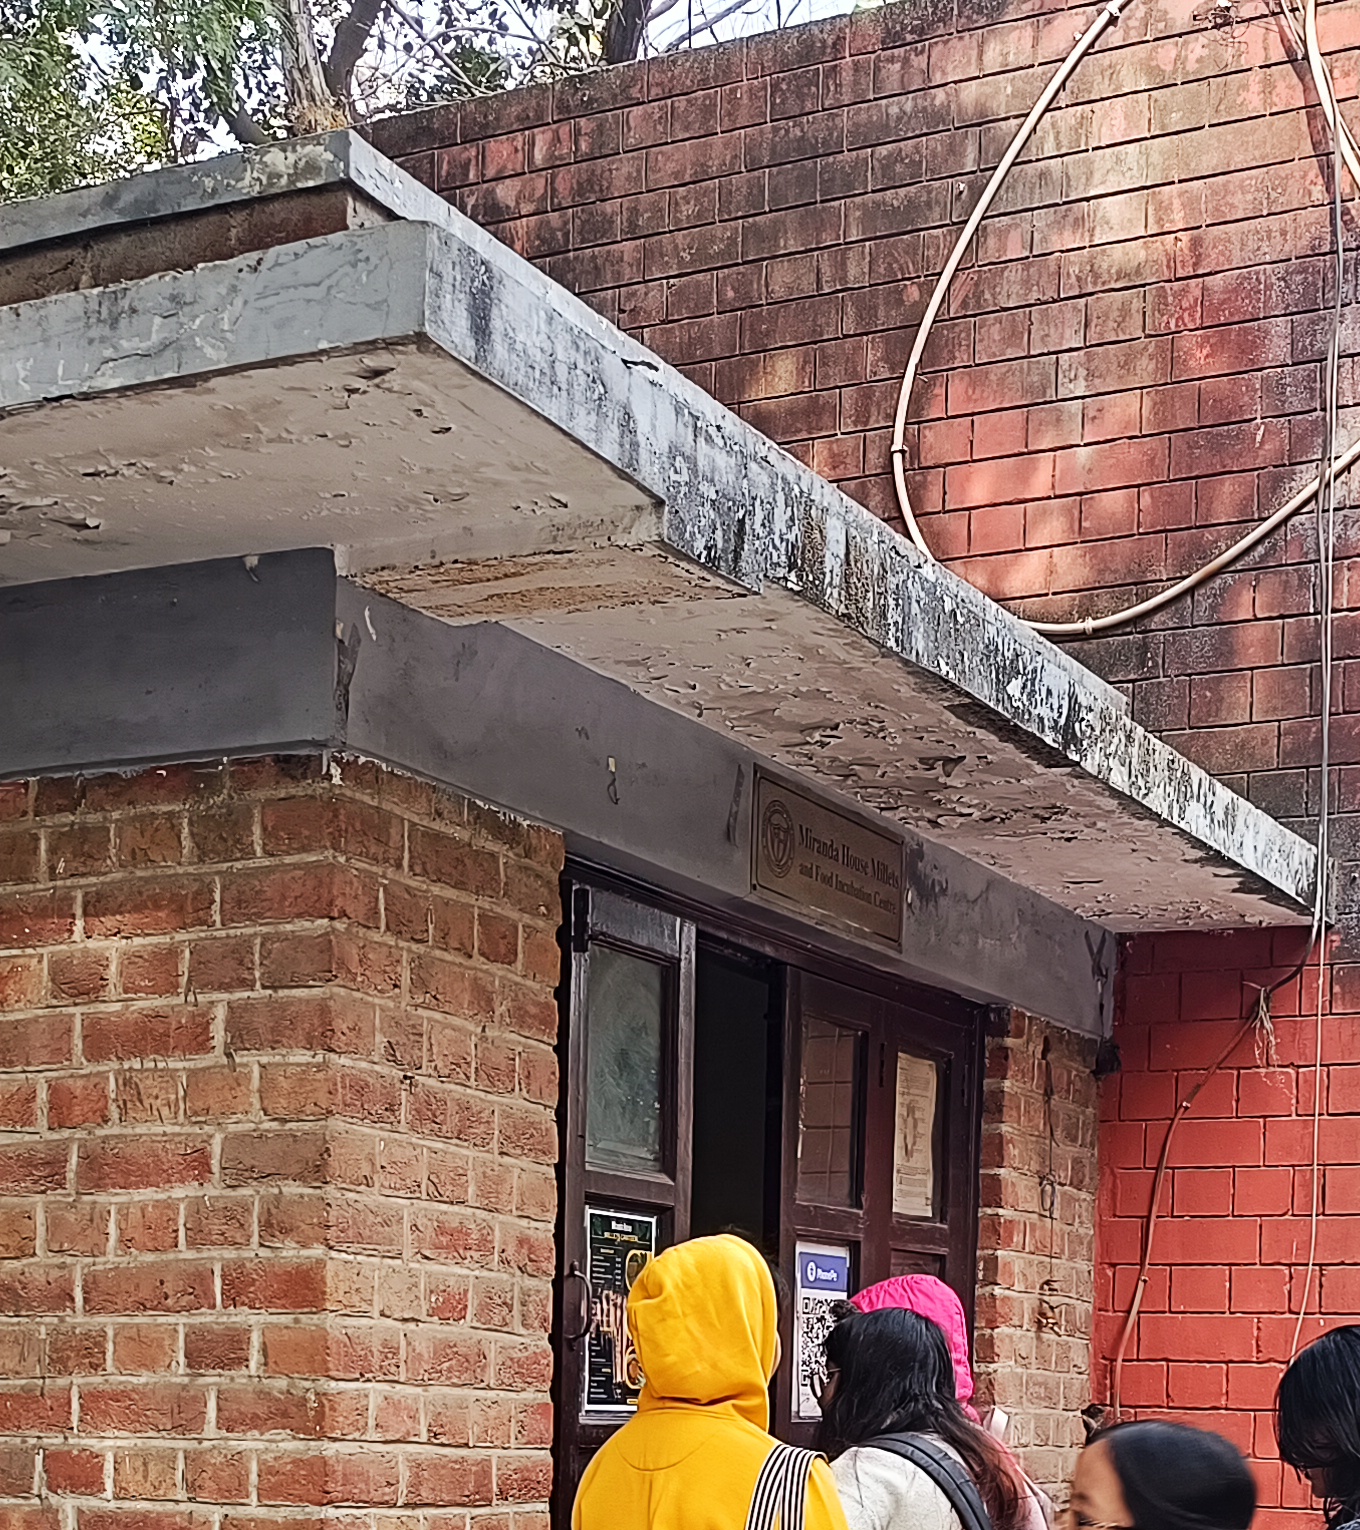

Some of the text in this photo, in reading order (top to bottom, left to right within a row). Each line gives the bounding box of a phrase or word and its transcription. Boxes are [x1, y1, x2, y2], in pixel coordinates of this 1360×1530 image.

[799, 824, 899, 889] Miranda House Millets
